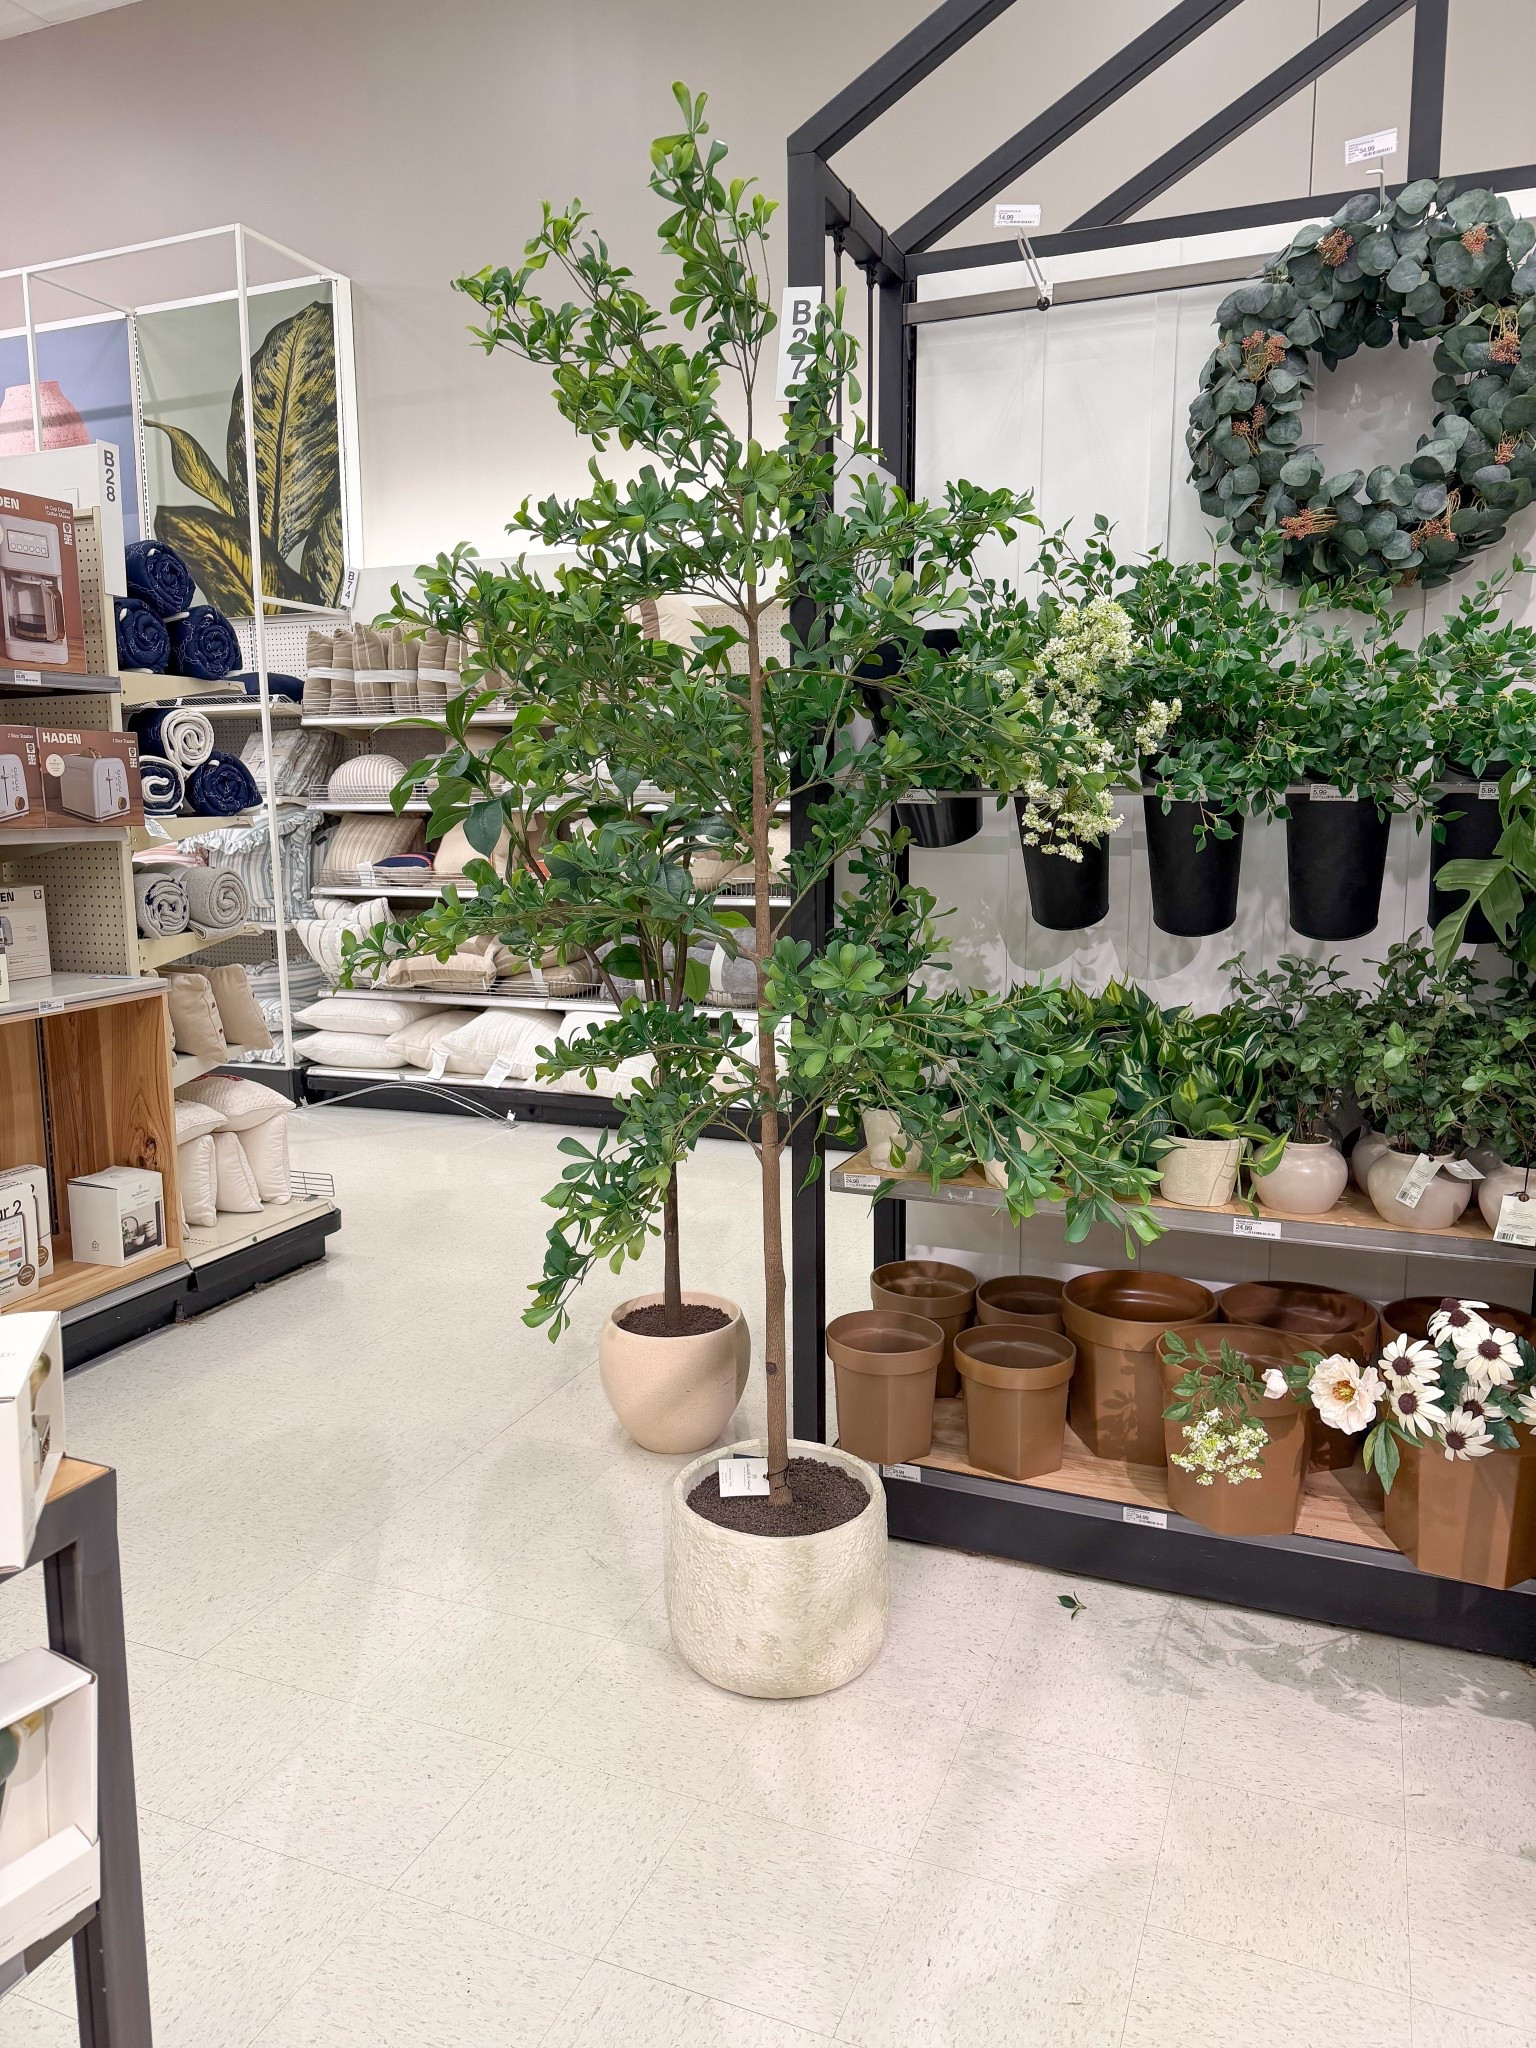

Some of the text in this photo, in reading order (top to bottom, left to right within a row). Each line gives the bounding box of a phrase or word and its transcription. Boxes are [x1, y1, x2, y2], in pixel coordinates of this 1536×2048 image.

[104, 449, 116, 502] B28
[345, 571, 355, 600] B74
[42, 732, 82, 745] HADEN
